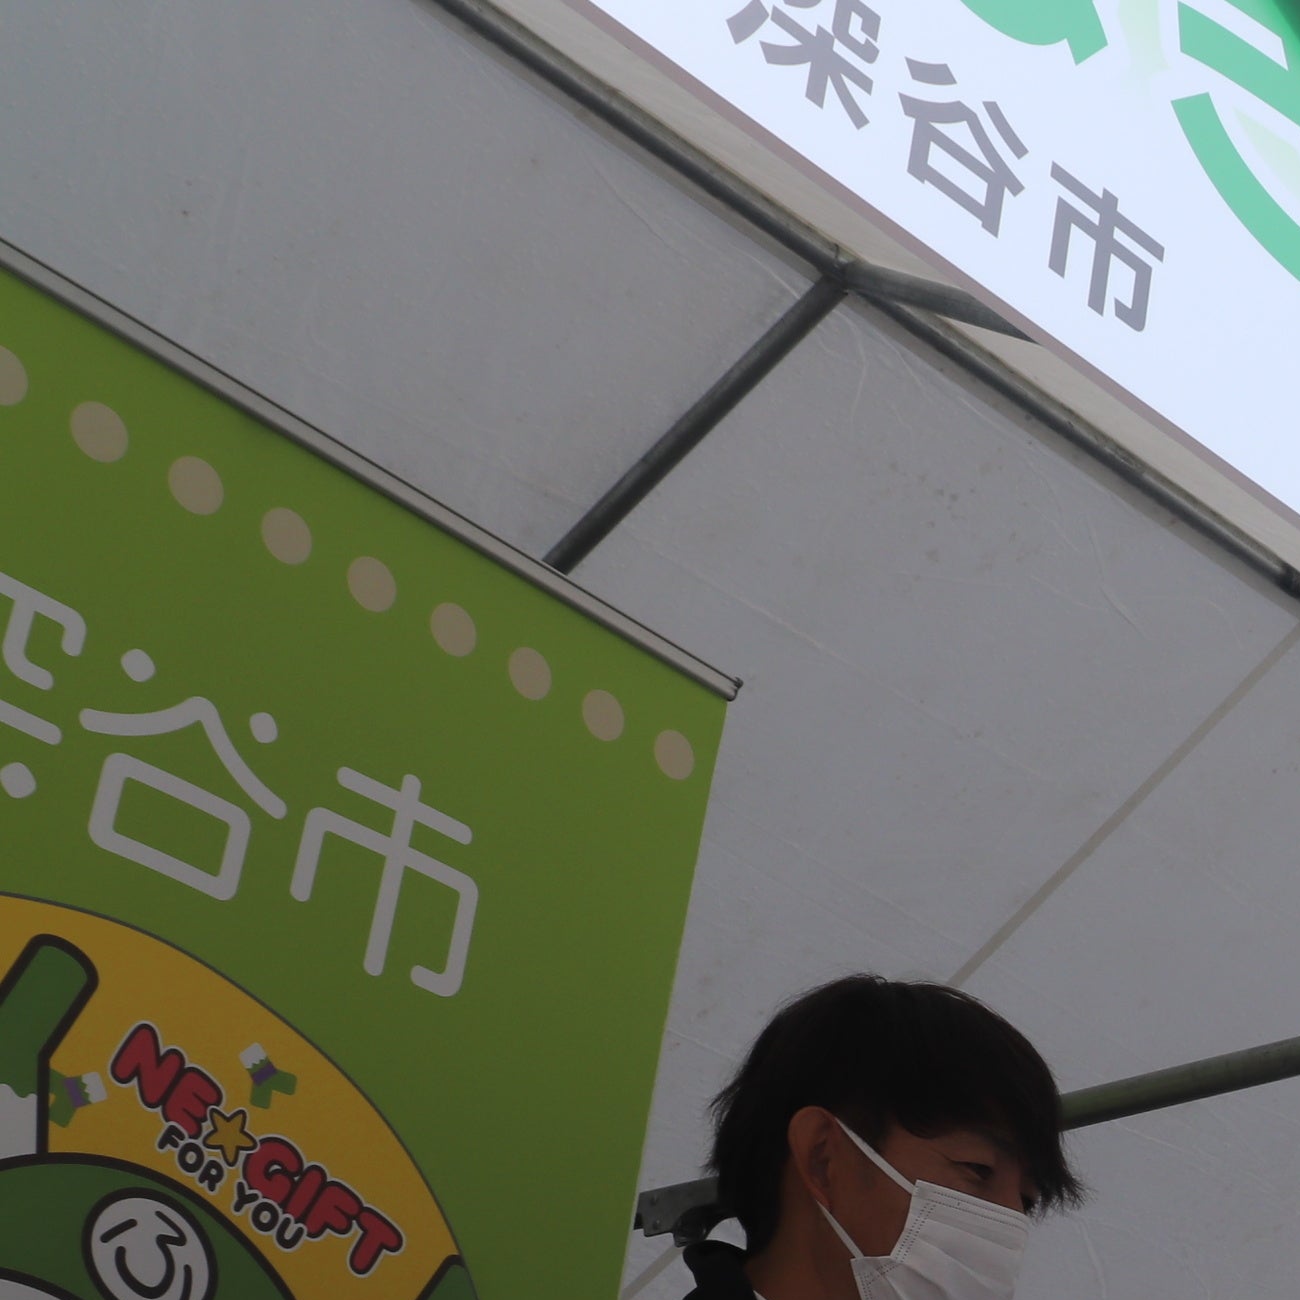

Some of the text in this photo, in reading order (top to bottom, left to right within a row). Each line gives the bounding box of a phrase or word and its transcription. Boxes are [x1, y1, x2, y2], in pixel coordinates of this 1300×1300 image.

[725, 0, 1165, 332] 深谷市
[157, 1122, 305, 1249] FOR YOU
